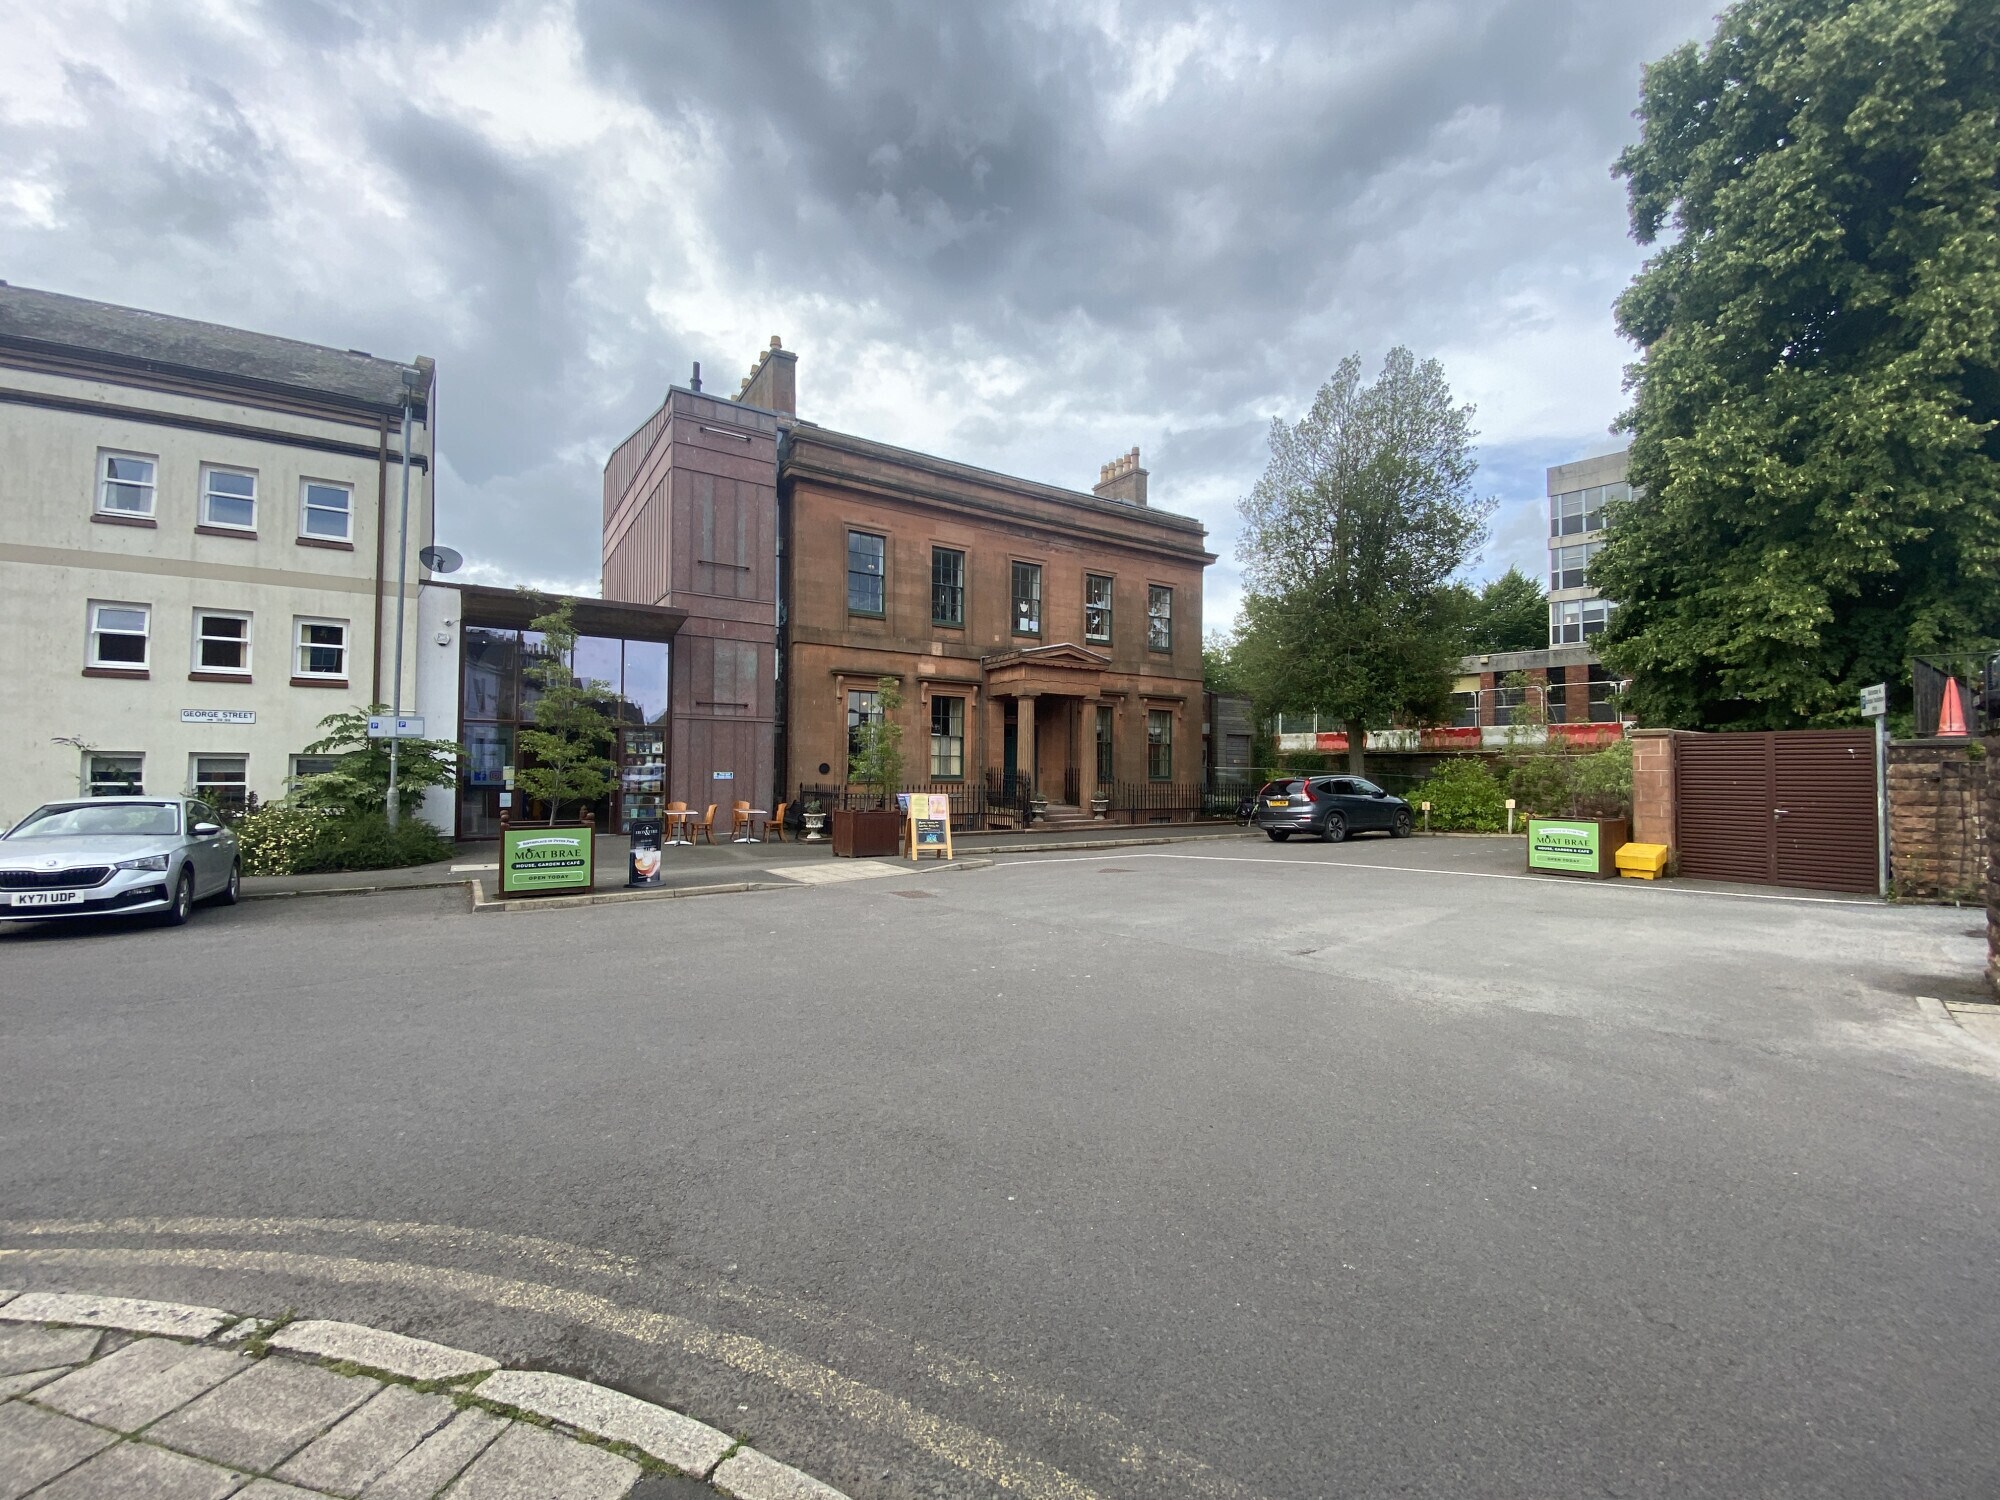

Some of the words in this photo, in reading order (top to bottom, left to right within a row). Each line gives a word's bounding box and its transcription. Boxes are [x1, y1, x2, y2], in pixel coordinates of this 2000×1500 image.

[1564, 838, 1590, 846] BRAE
[514, 850, 547, 859] MOAT
[551, 849, 581, 858] BRAE
[19, 893, 47, 904] KY71
[50, 892, 76, 903] UDP
